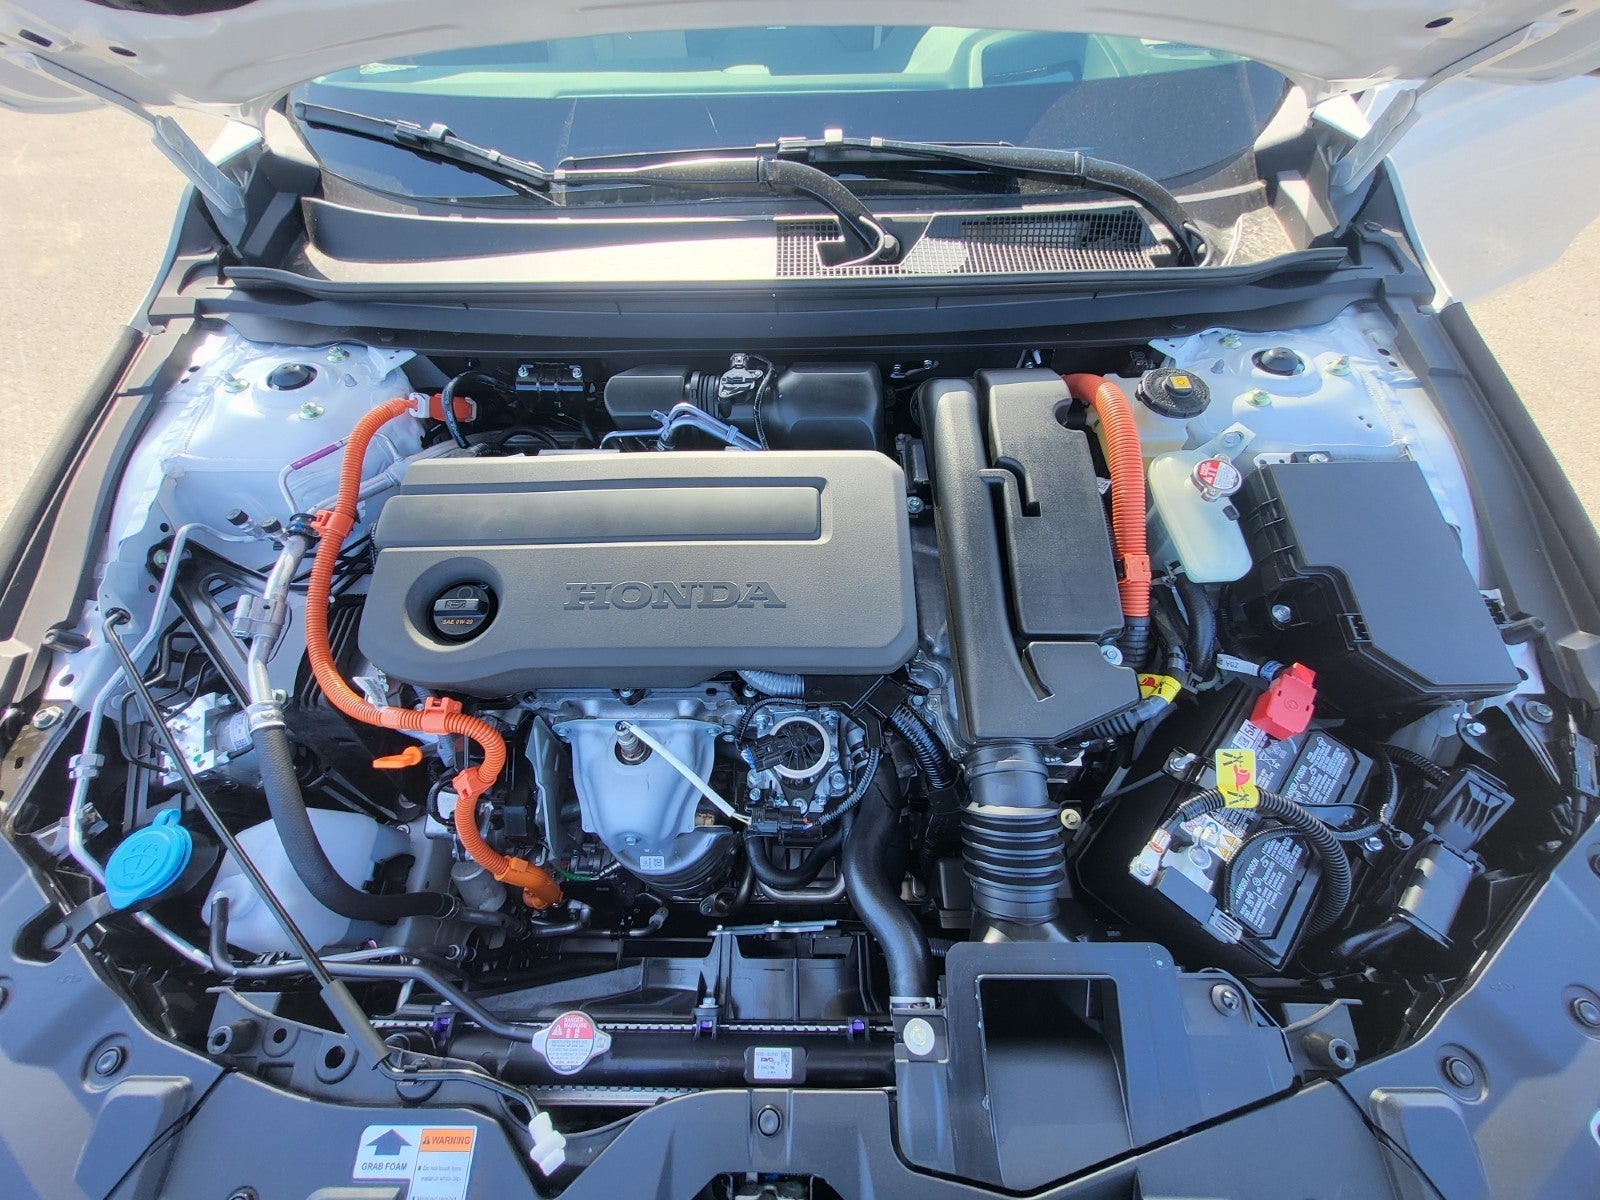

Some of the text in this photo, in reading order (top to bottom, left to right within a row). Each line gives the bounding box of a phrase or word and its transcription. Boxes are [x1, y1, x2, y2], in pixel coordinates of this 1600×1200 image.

[563, 580, 787, 611] HONDA
[432, 1136, 471, 1145] WARNING
[361, 1162, 408, 1171] GRAB FOAM
